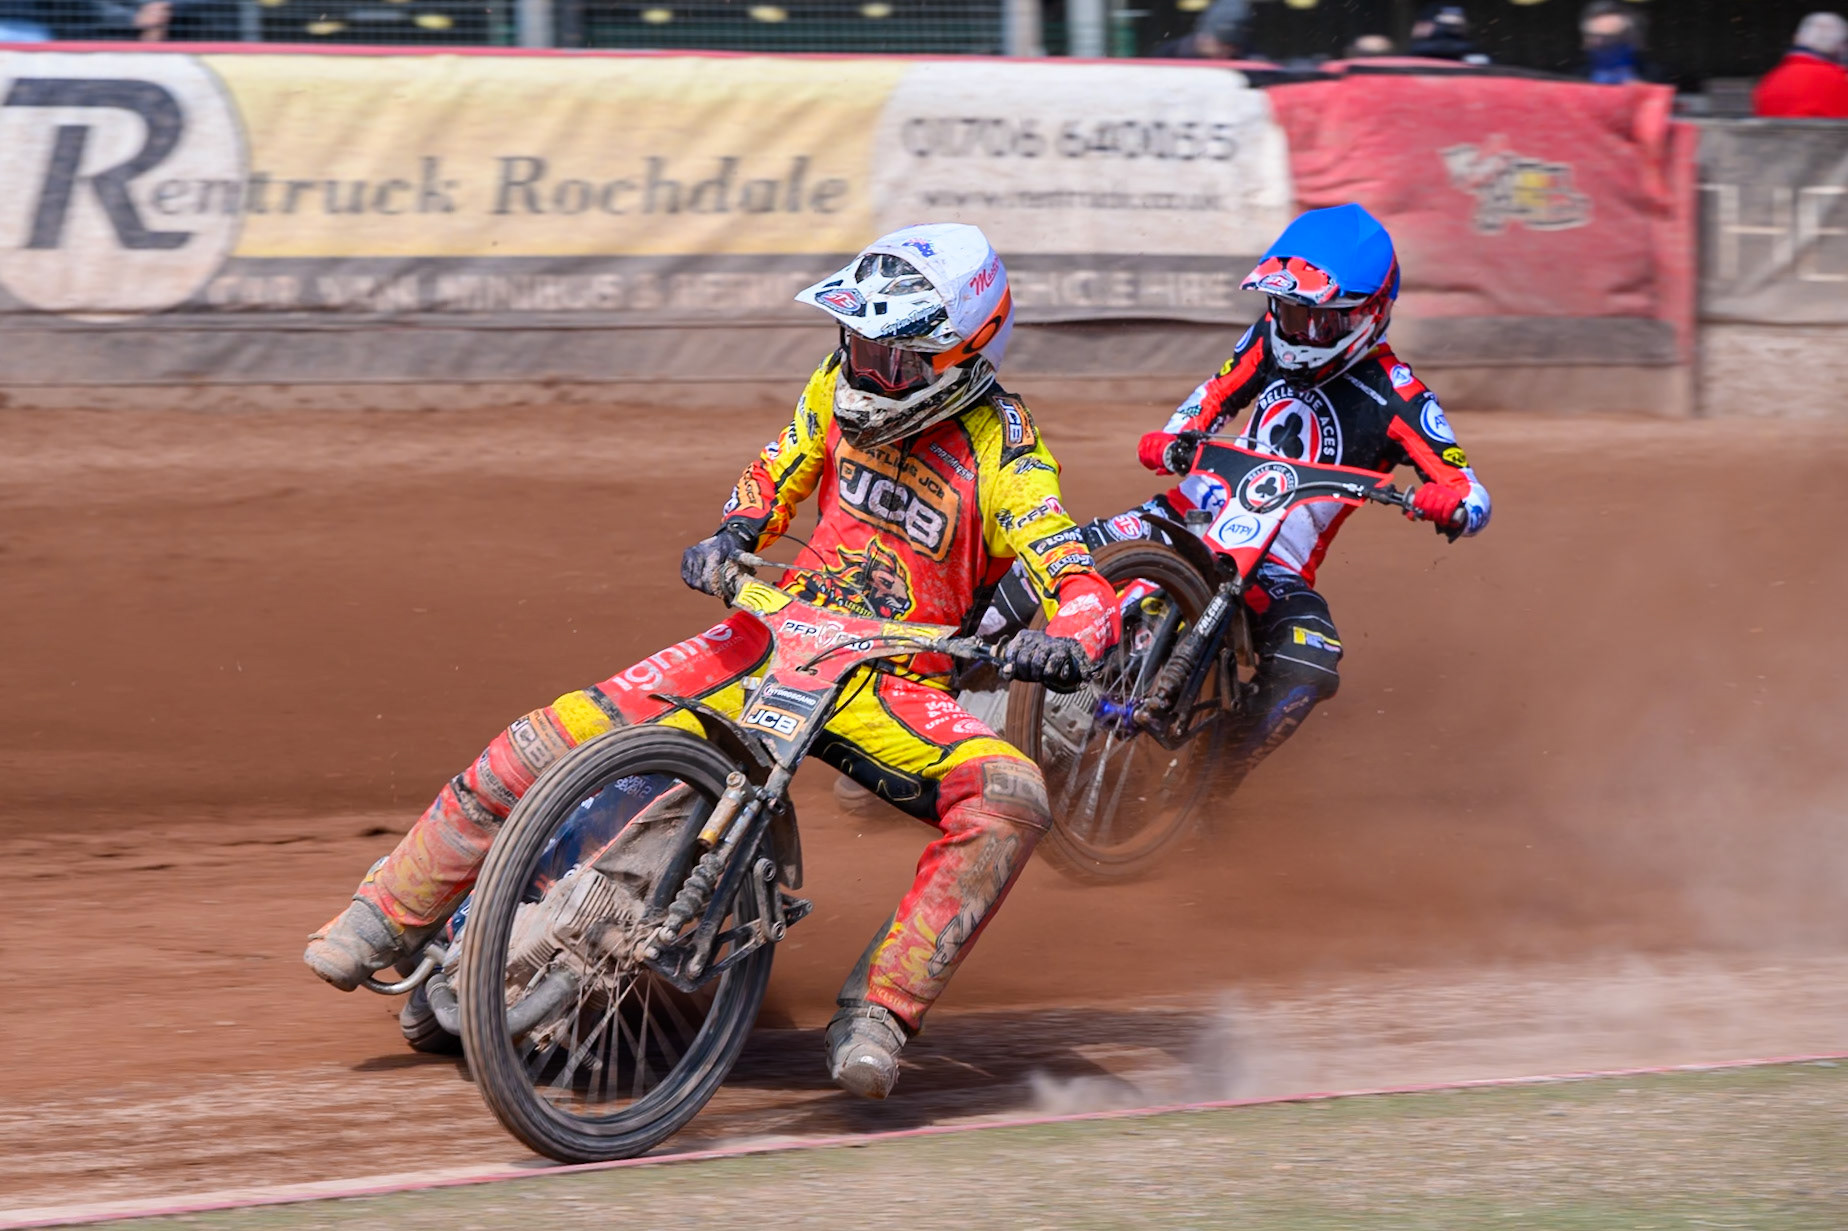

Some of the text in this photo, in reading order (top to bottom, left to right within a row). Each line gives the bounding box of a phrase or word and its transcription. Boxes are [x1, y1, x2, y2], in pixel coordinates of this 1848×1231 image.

[493, 156, 850, 215] Rochdale
[1258, 386, 1294, 409] BELLE
[1319, 416, 1336, 457] ACES
[839, 470, 945, 549] JCB
[1225, 523, 1253, 536] ATPI
[1198, 596, 1223, 634] FALCON
[749, 709, 798, 734] JCB
